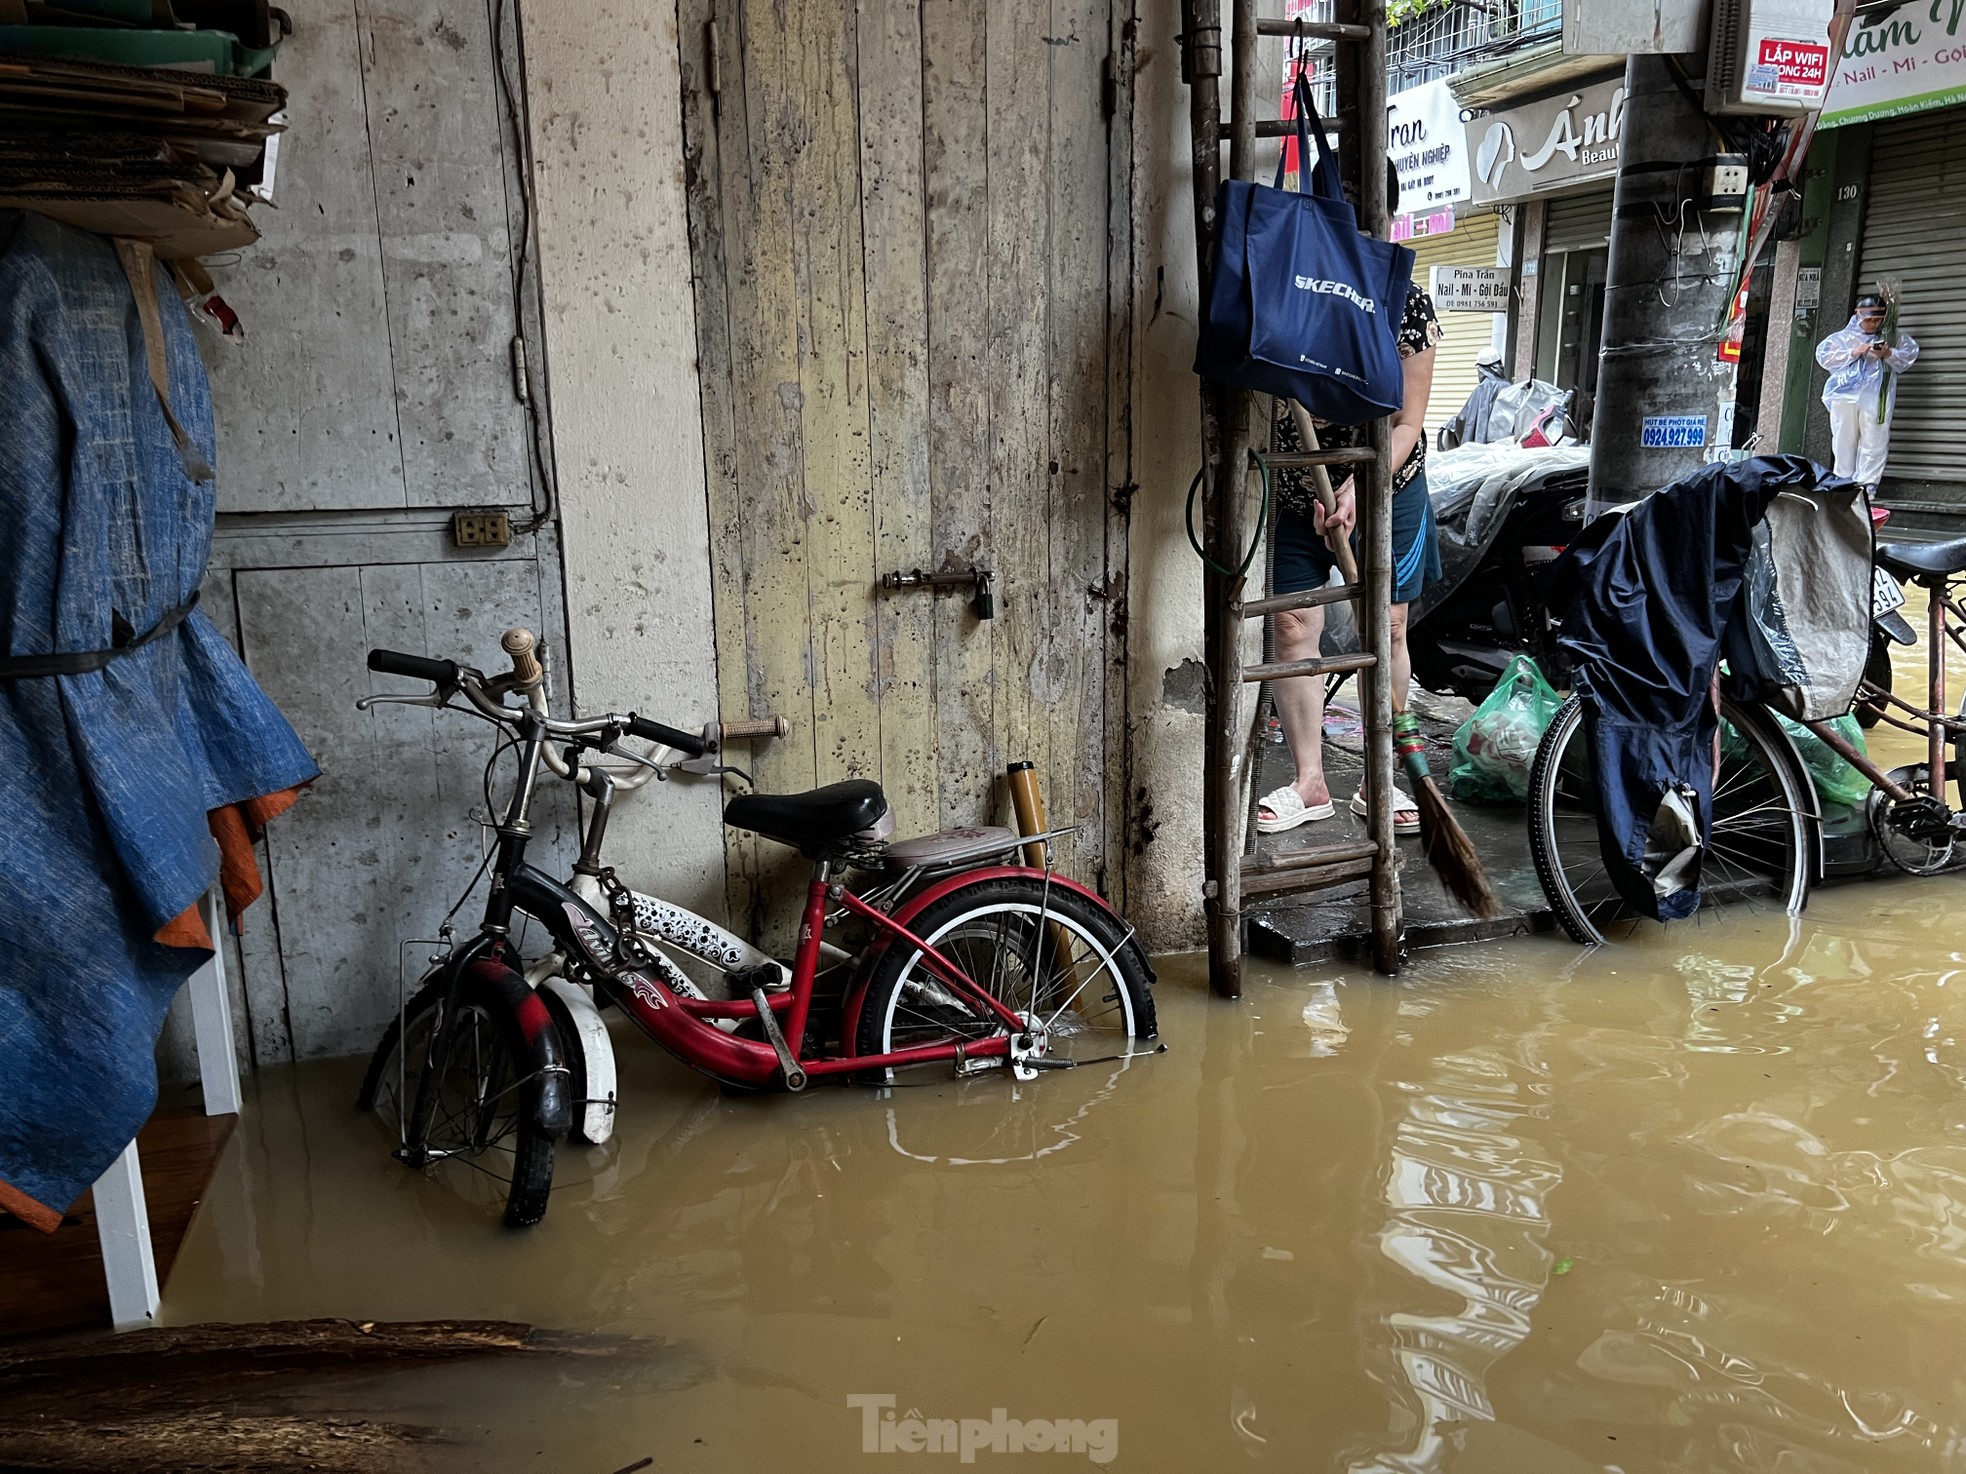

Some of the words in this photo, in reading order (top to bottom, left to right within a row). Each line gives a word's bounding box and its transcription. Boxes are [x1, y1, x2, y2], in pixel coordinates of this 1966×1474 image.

[1794, 51, 1823, 67] WIFI
[1764, 63, 1801, 77] ONG
[1801, 66, 1822, 79] 24H
[1843, 66, 1876, 85] Nail
[1893, 57, 1916, 73] Mi
[1838, 184, 1857, 201] 130
[1454, 269, 1473, 279] Pina
[1295, 275, 1376, 314] SKECHER
[1438, 283, 1454, 296] Nail
[1461, 283, 1471, 296] Mi
[1643, 428, 1704, 446] 0924.927.999
